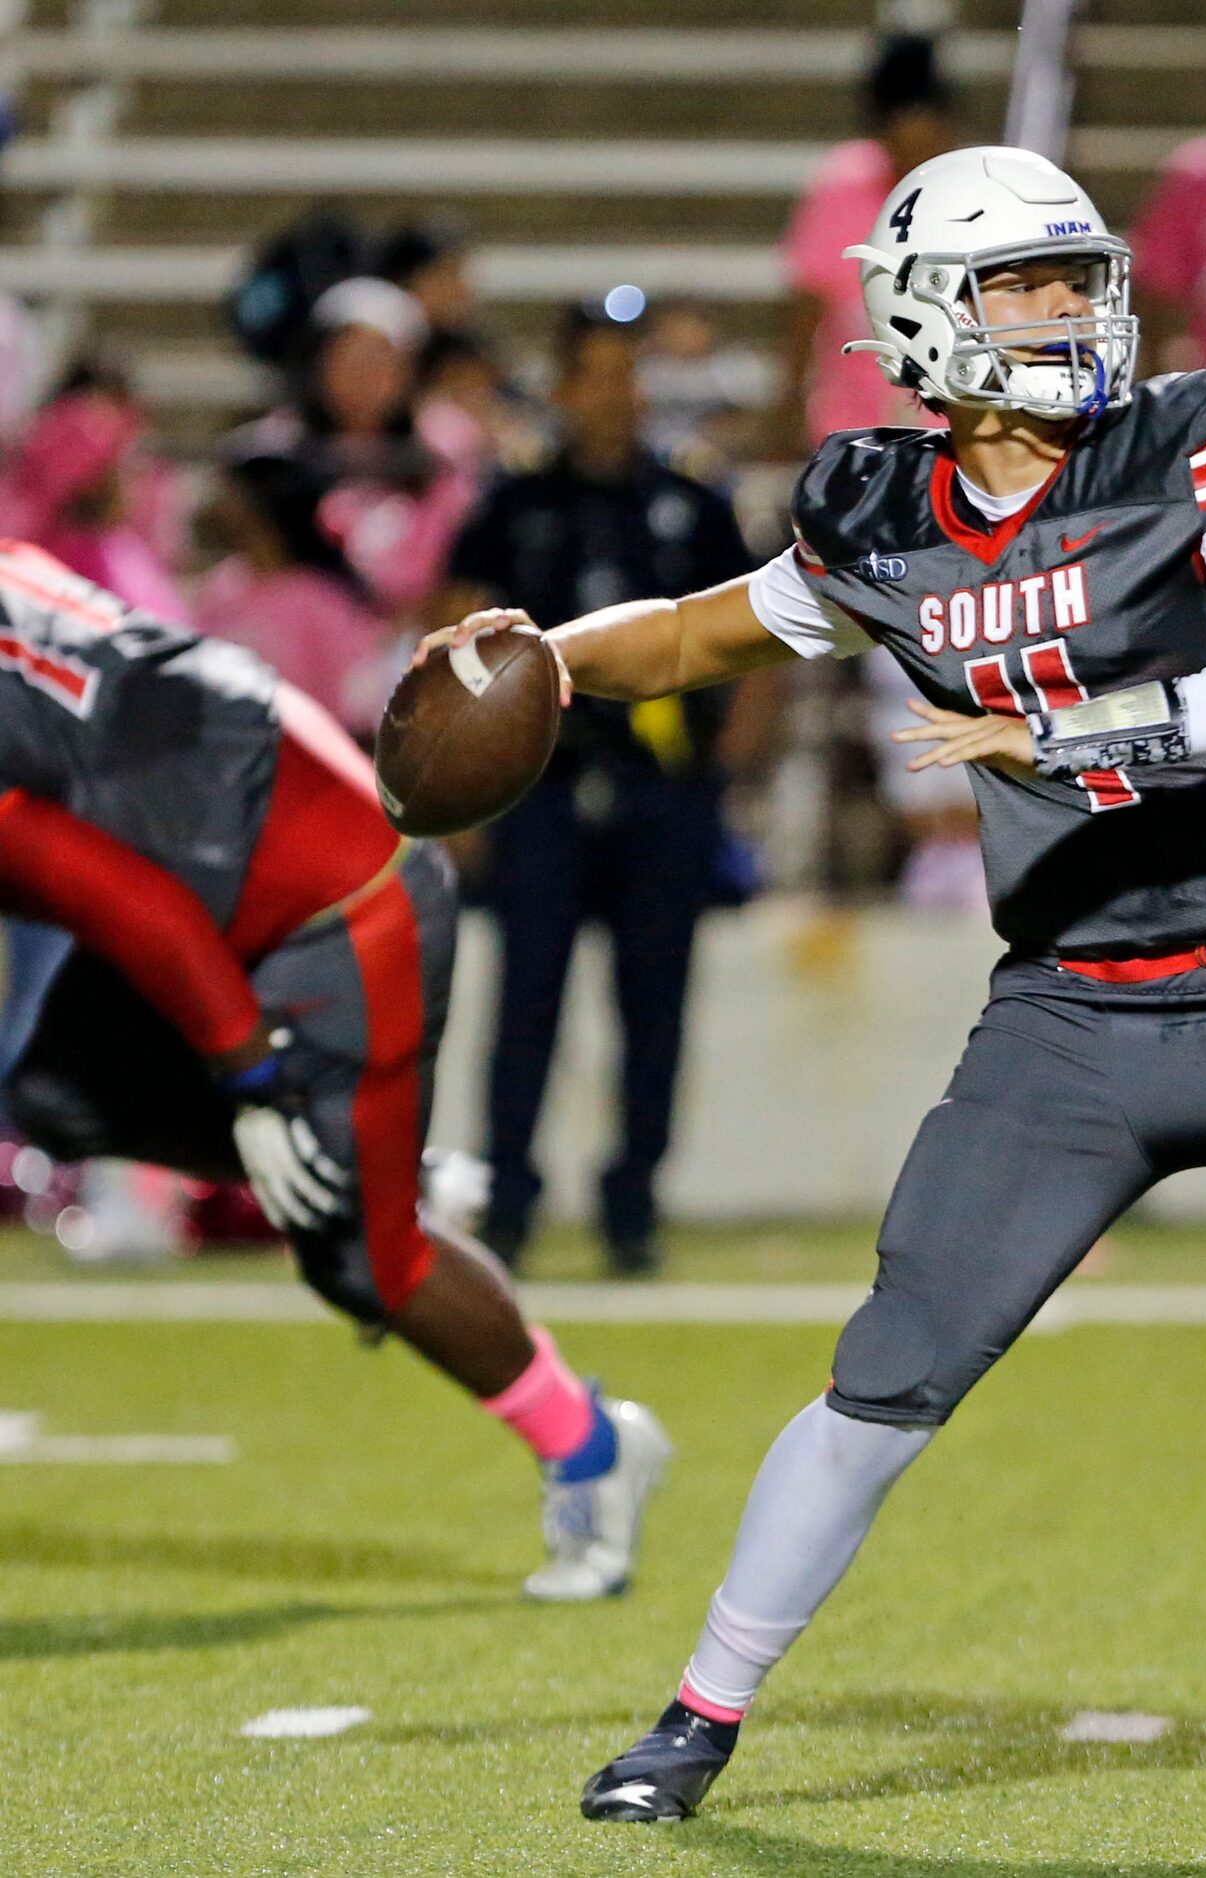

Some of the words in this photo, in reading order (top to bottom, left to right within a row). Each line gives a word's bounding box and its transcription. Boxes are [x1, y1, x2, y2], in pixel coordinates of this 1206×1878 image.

[889, 188, 922, 243] 4
[1044, 221, 1091, 237] INAM
[919, 564, 1088, 655] SOUTH
